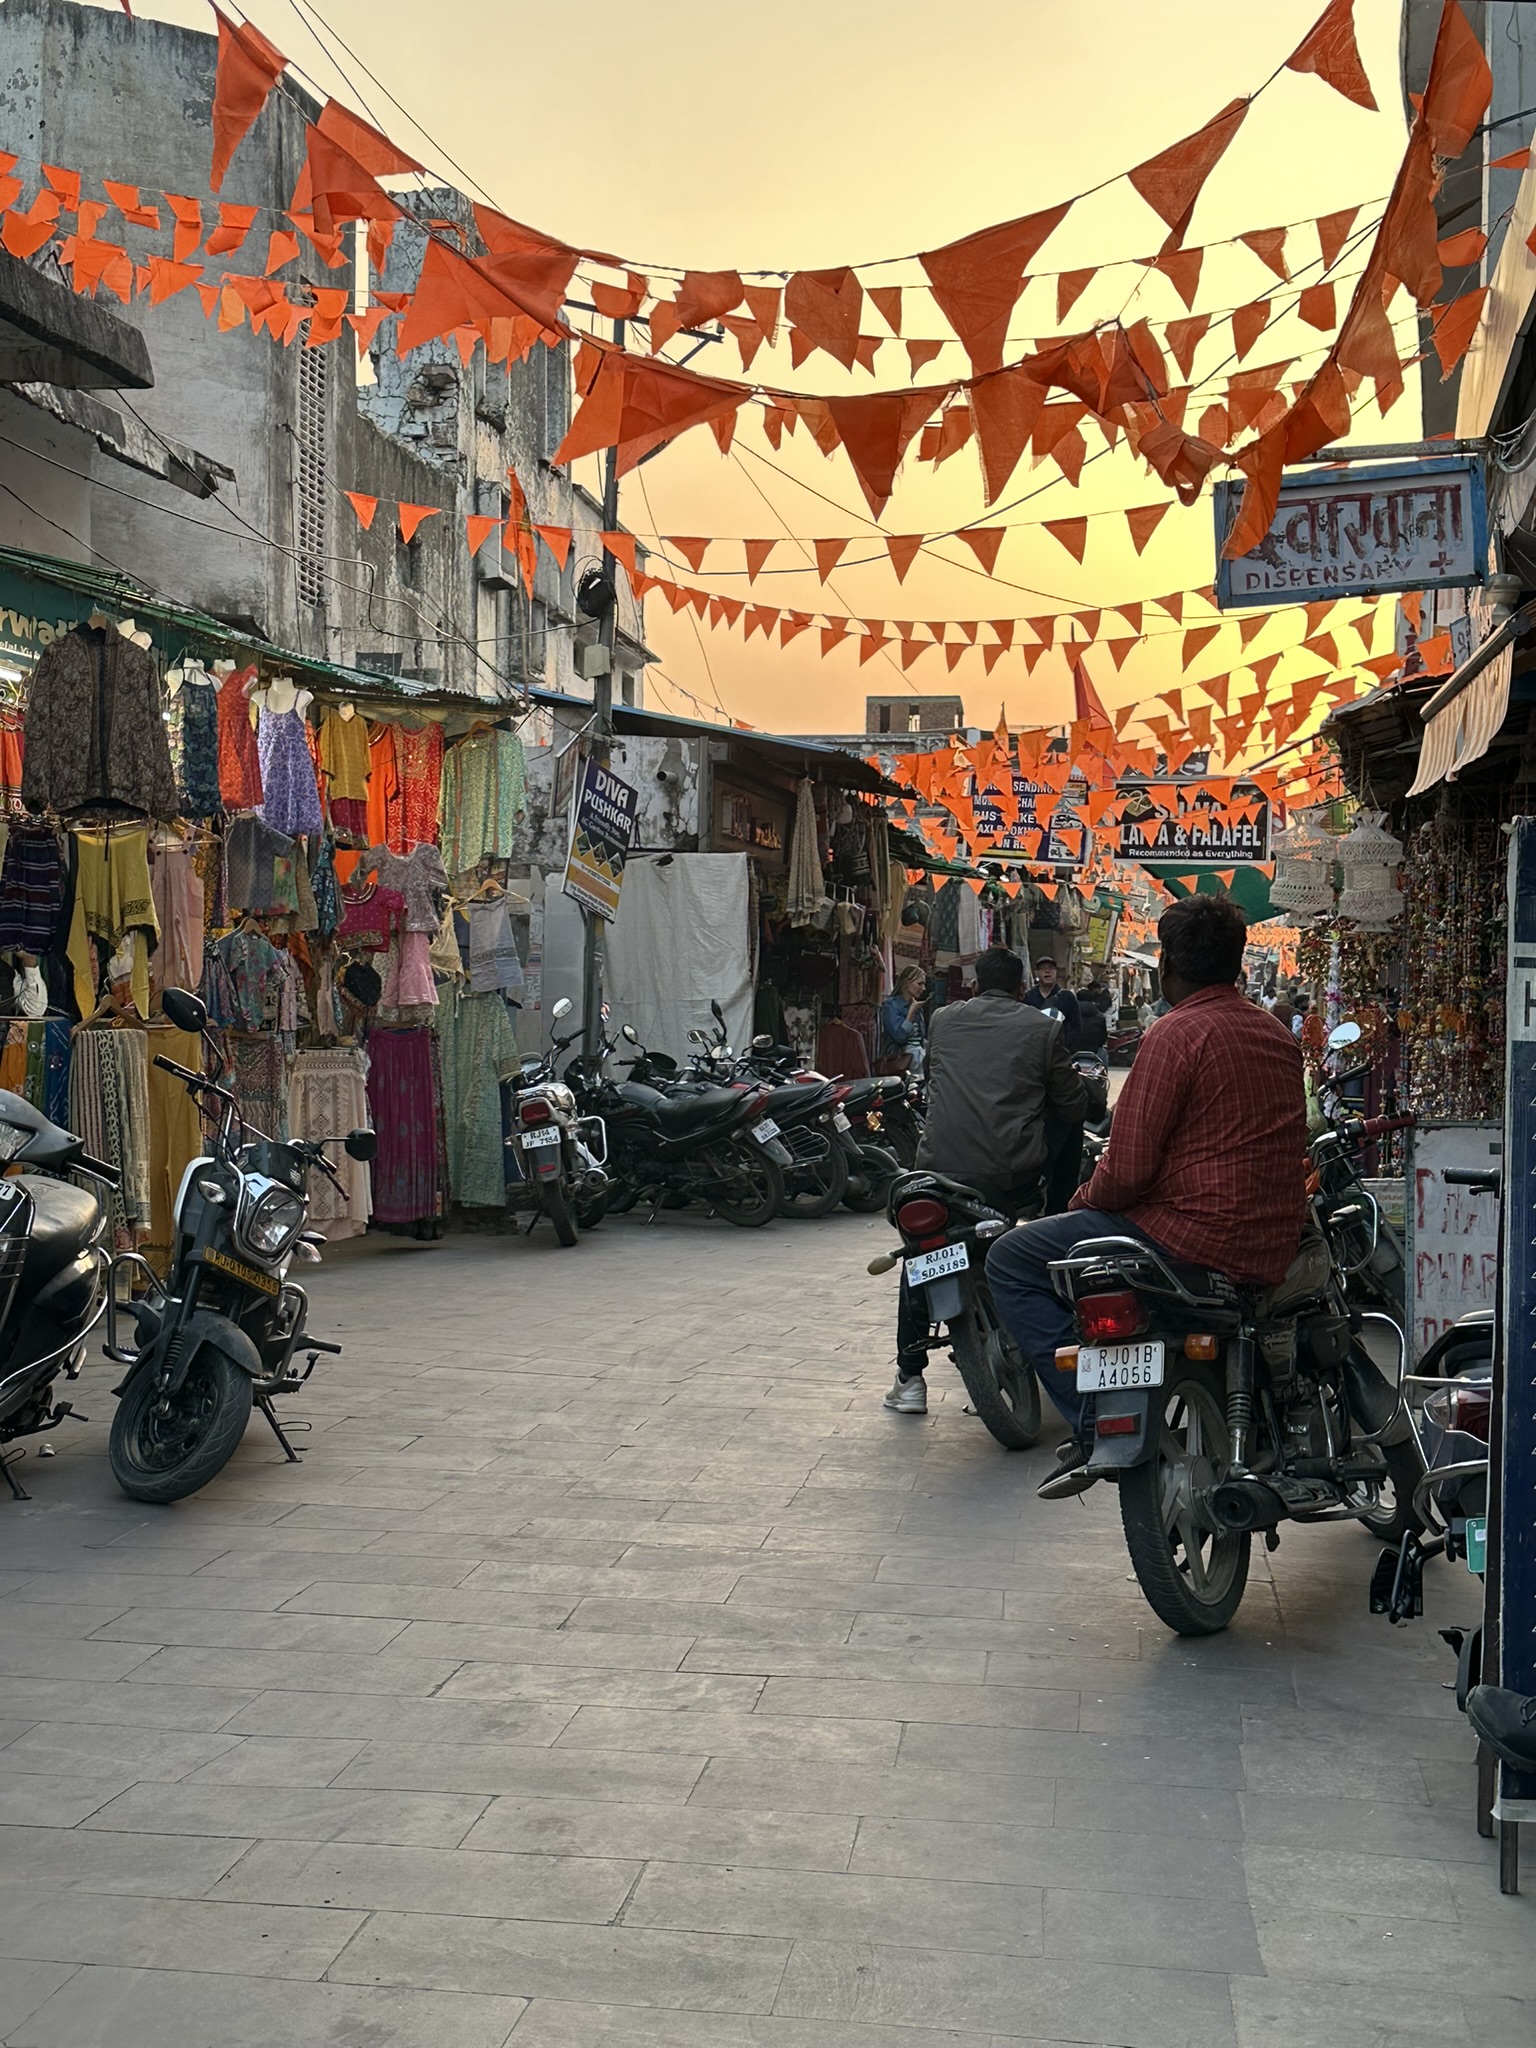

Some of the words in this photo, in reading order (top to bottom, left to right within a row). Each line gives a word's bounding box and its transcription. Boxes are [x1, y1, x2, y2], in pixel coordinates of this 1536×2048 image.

[595, 769, 629, 809] DIVA
[583, 788, 632, 834] PUSHKAR
[1174, 824, 1188, 846] &
[1192, 824, 1261, 846] FALAFEL
[1129, 848, 1190, 857] Recommended
[1192, 850, 1203, 858] as
[1205, 849, 1253, 859] Everything
[921, 1258, 967, 1280] SD.8189
[1099, 1345, 1153, 1367] RJ01B
[1098, 1366, 1151, 1388] A4056
